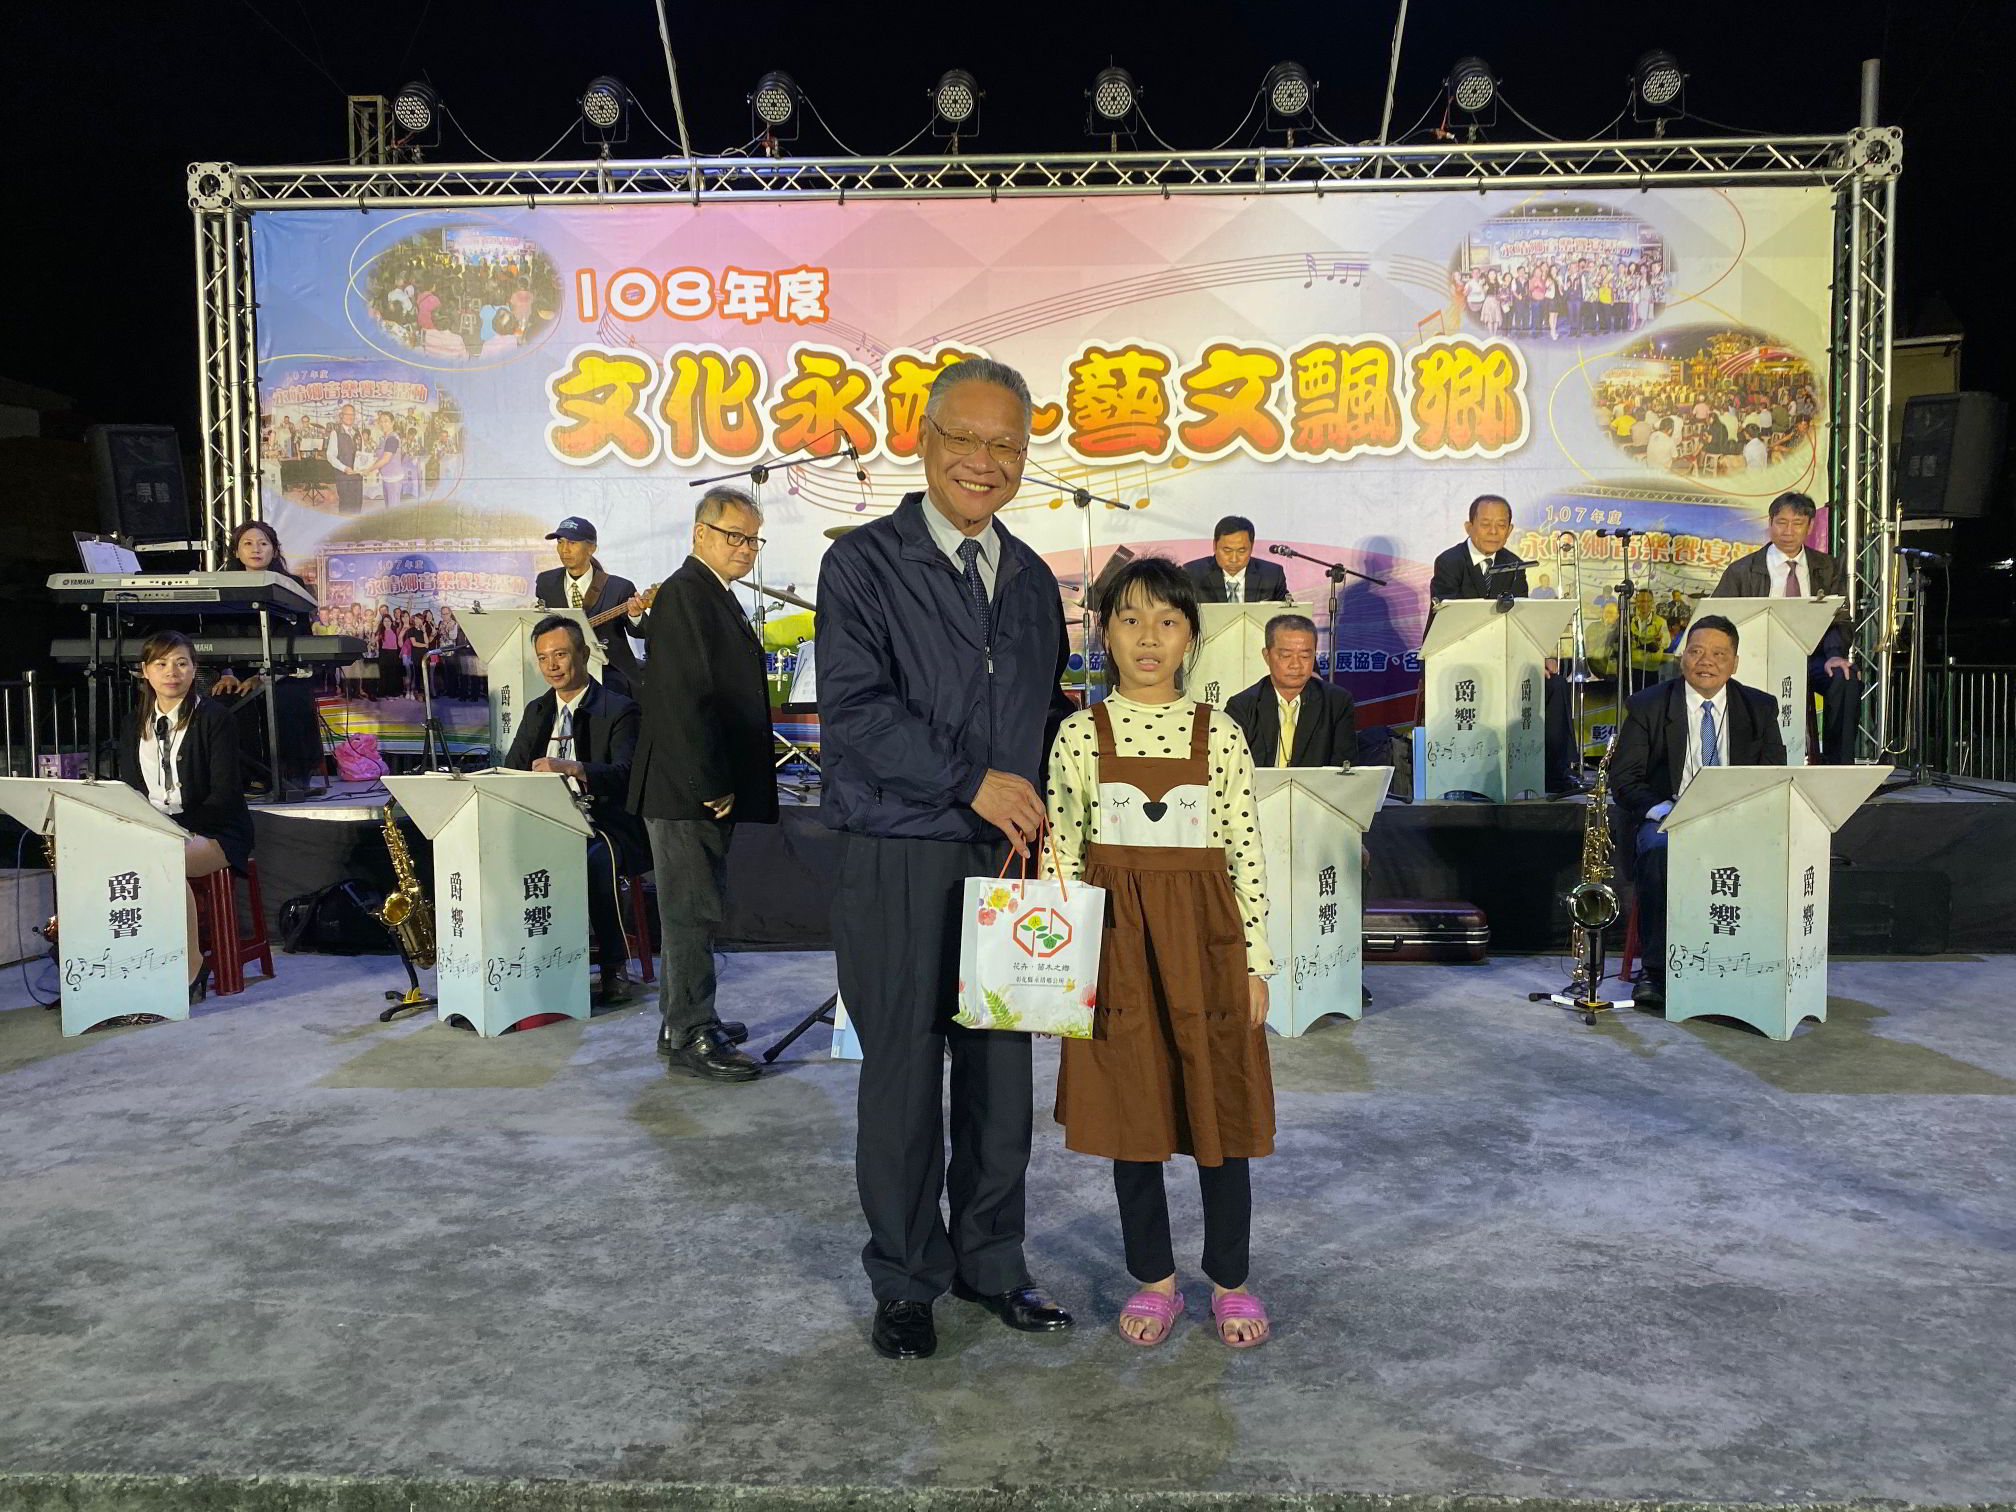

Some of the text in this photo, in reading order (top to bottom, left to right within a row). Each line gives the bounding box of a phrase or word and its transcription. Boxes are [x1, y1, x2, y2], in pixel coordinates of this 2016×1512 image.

[577, 265, 828, 324] 108年度
[1545, 505, 1624, 525] 107年度
[1455, 679, 1476, 731] 爵響
[109, 871, 142, 939] 爵響
[450, 872, 463, 938] 爵響
[524, 869, 552, 938] 爵響
[1319, 865, 1337, 935] 爵響
[1709, 866, 1741, 936] 爵響
[1803, 865, 1815, 937] 爵響
